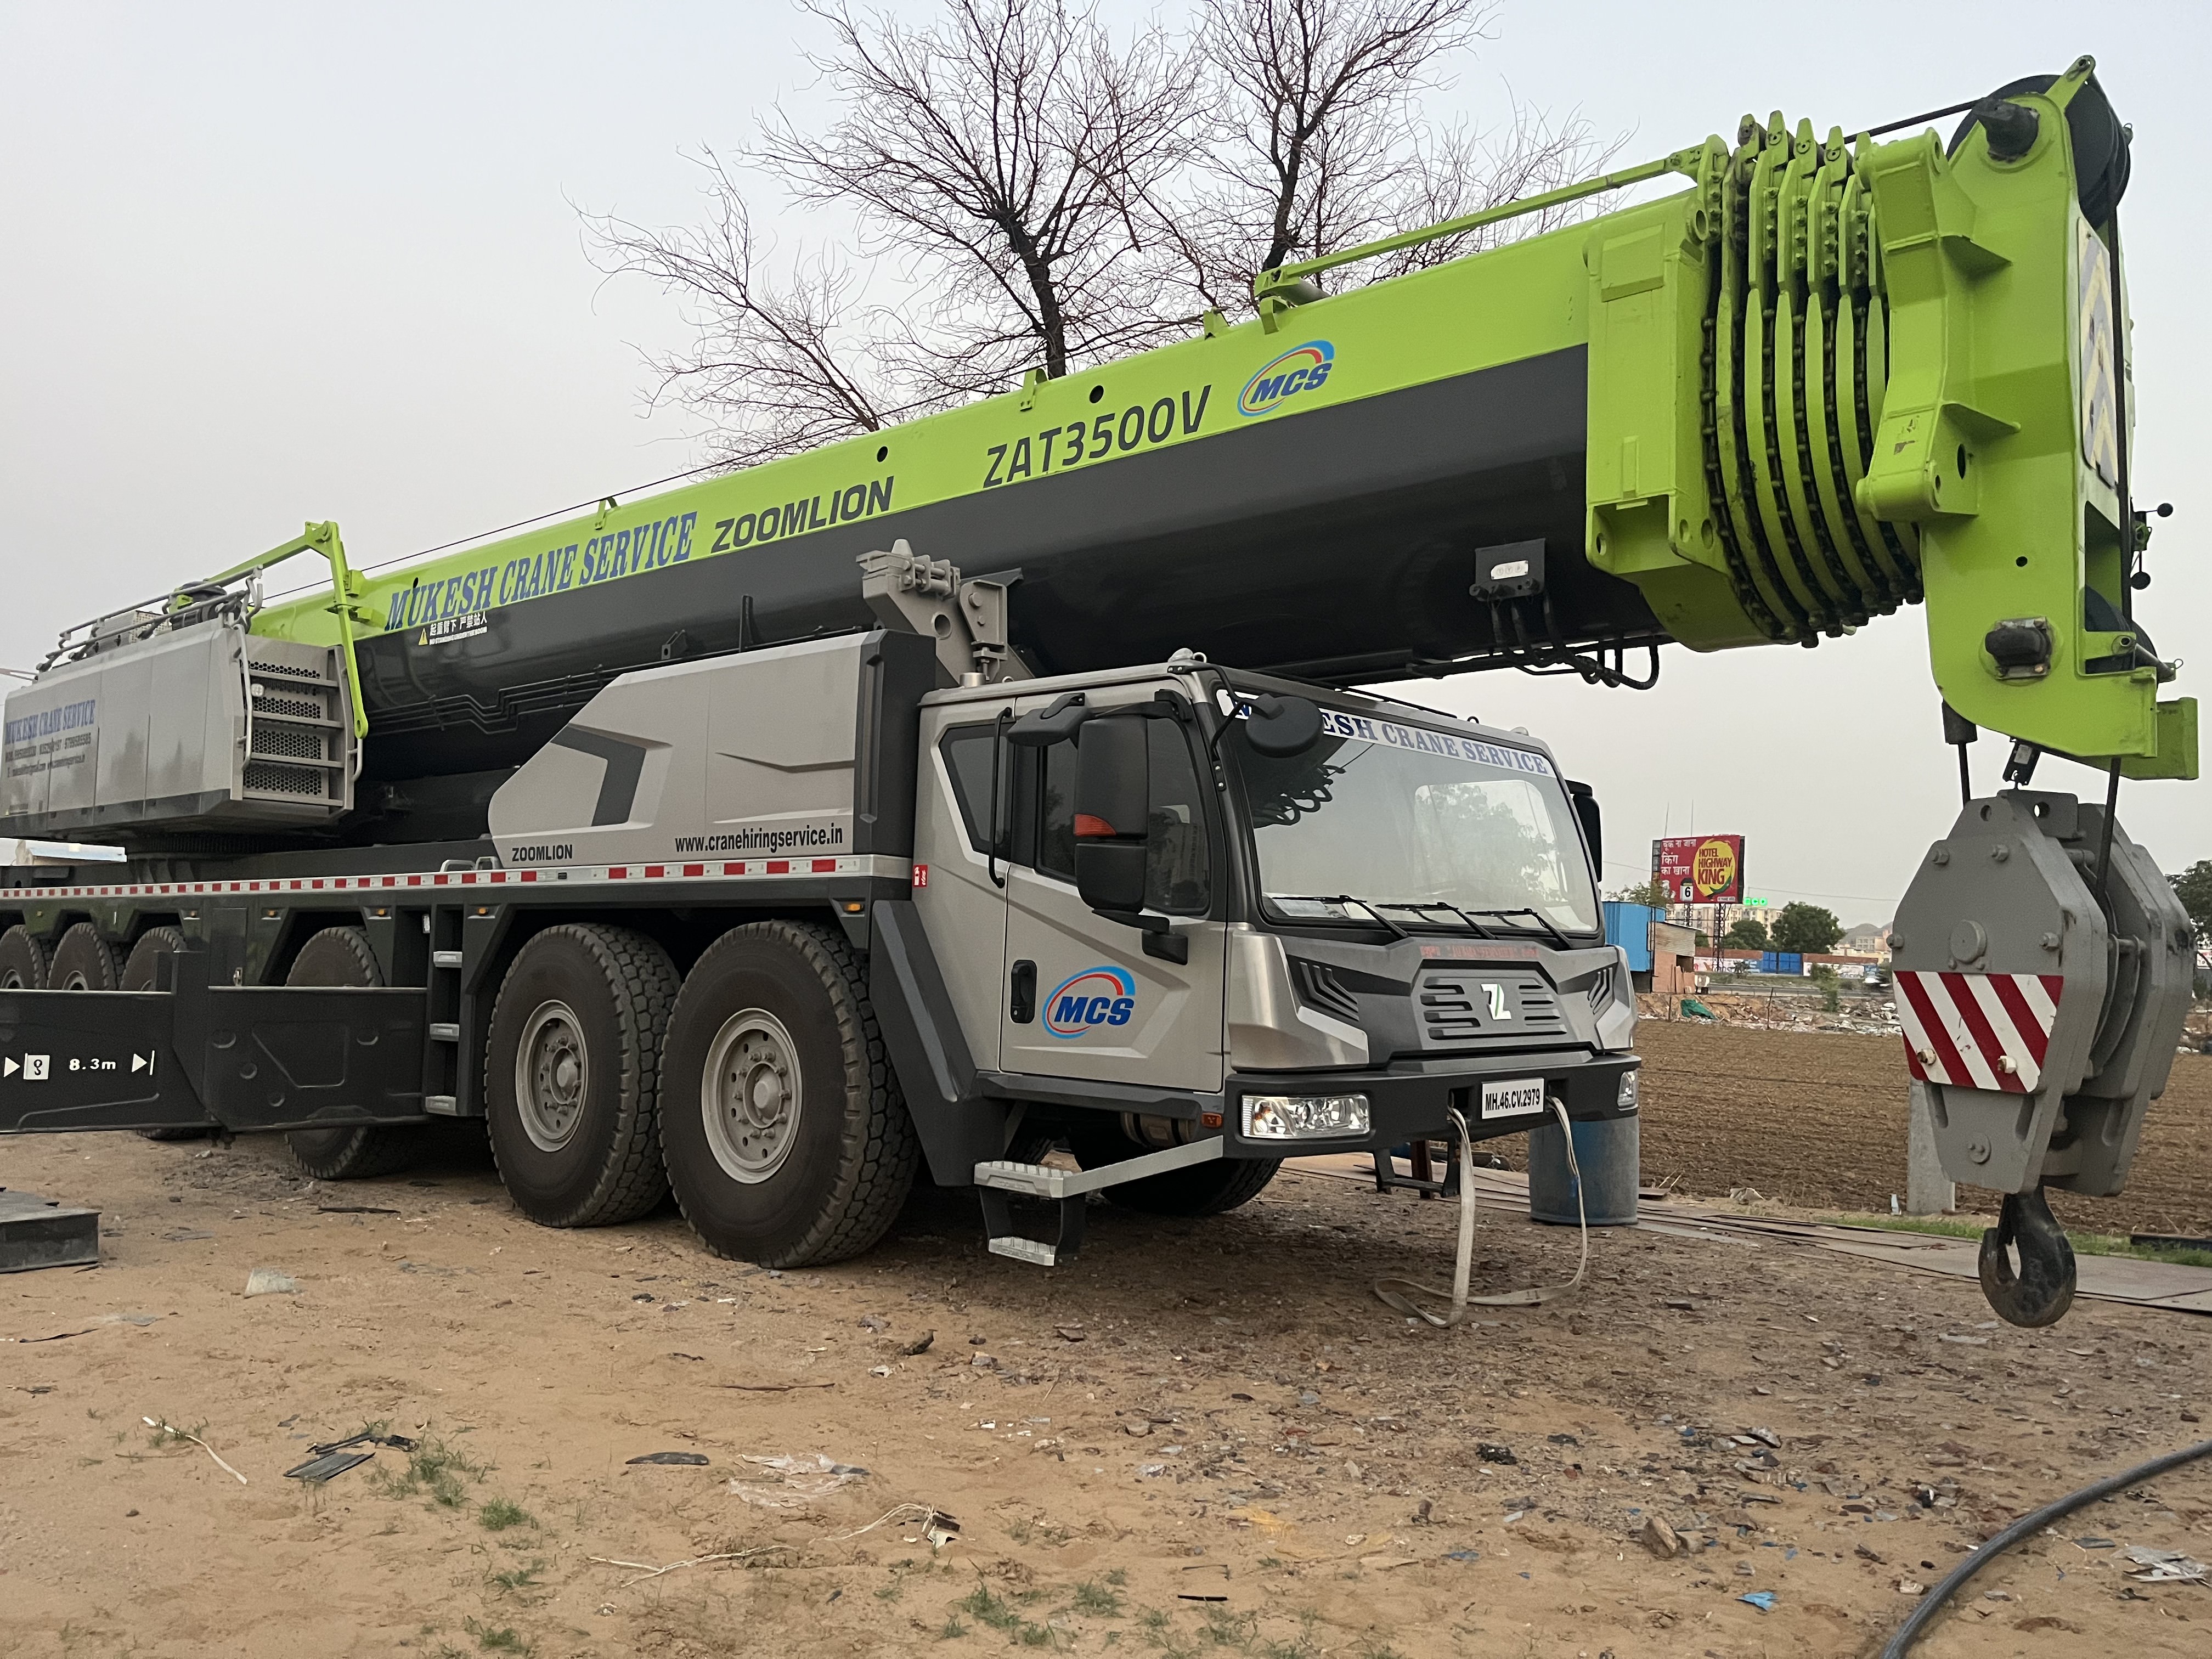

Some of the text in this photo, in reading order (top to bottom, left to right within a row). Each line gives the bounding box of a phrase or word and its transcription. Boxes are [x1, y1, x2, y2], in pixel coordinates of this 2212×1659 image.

[1250, 362, 1333, 404] MCS
[983, 385, 1211, 488] ZAT3500V
[710, 476, 895, 554] ZOOMLION
[385, 511, 698, 631] MUKESH CRANE SERVICE
[5, 714, 38, 745] MUKESH
[63, 699, 95, 730] SERVICE
[1381, 723, 1460, 758] CRANE
[1462, 739, 1548, 775] SERVICE
[675, 823, 843, 854] www.cranehiringservice.in
[512, 844, 573, 862] ZOOMLION
[1661, 851, 1678, 865] किंग
[1699, 848, 1719, 857] HOTEL
[1699, 857, 1733, 868] HIGHWAY
[1661, 866, 1690, 875] का खाना
[1698, 868, 1725, 885] KING
[1685, 887, 1691, 897] 6
[1054, 996, 1135, 1025] MCS
[69, 1058, 116, 1071] 8.3m
[1485, 1088, 1541, 1111] MH.46.CV.2979
